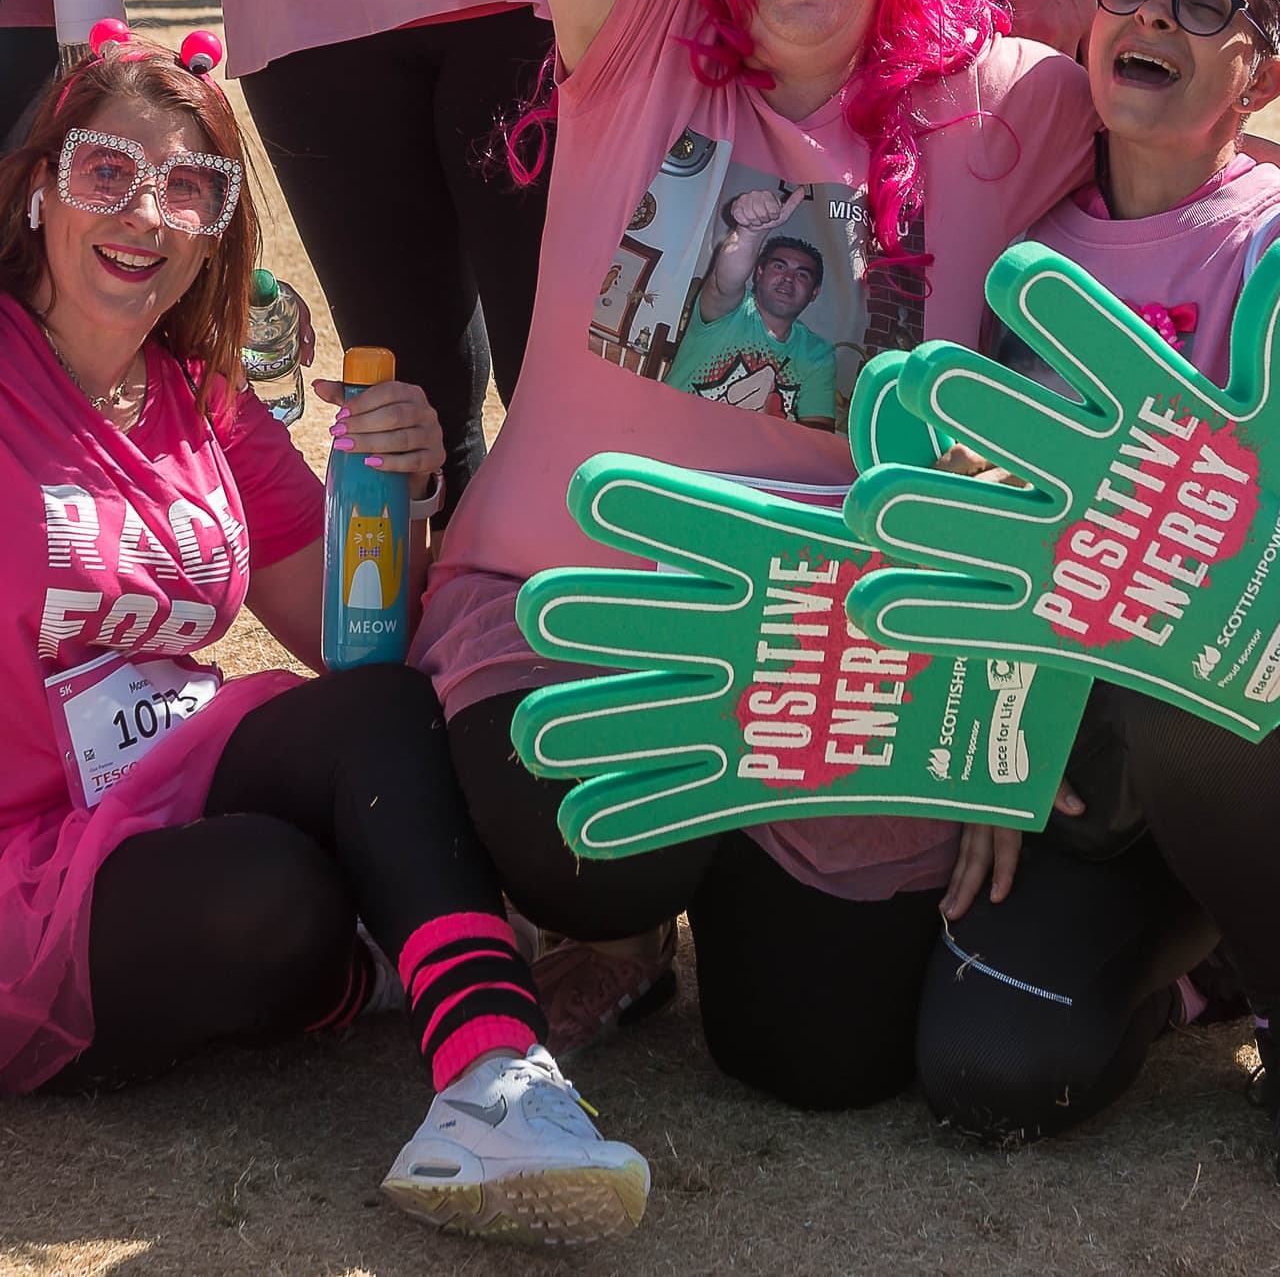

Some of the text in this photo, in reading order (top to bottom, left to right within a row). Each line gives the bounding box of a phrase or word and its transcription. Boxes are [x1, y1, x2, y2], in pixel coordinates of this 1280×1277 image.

[829, 200, 868, 227] MISS
[1033, 396, 1199, 635] POSITIVE
[1108, 444, 1251, 647] ENERGY
[38, 587, 217, 659] FOR
[349, 620, 398, 634] MEOW
[737, 557, 841, 781] POSITIVE
[1218, 628, 1262, 689] Proud sponsor
[1252, 664, 1276, 696] Race
[59, 684, 73, 698] 5K
[961, 719, 981, 781] Proud sponsor
[997, 694, 1016, 777] Race for Life
